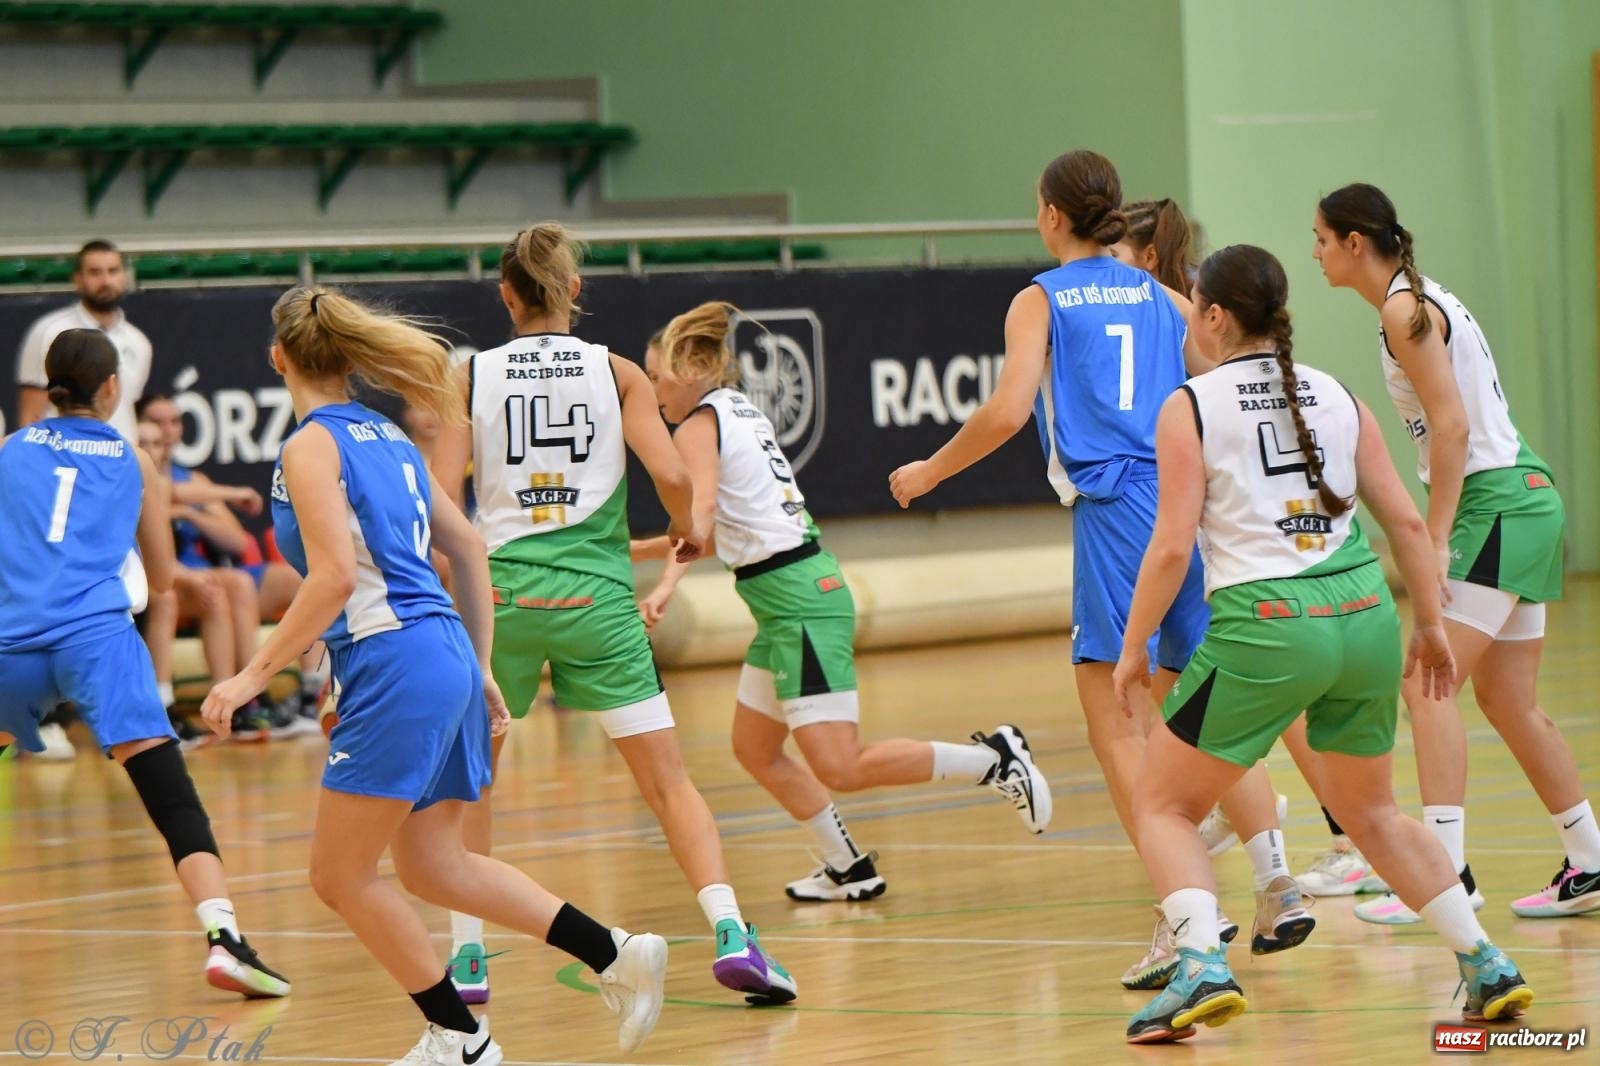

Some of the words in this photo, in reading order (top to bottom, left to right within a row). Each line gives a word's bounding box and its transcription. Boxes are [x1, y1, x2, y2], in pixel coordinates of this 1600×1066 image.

[1055, 287, 1083, 308] AZS
[1082, 282, 1102, 304] UŚ
[508, 352, 541, 363] RKK
[552, 351, 582, 362] AZS
[1105, 324, 1133, 411] 7
[506, 364, 585, 379] RACIBÓRZ
[871, 354, 1004, 427] RACI
[1236, 382, 1271, 395] RKK
[1238, 396, 1318, 411] RACIBRZ
[505, 394, 595, 466] 14
[1257, 421, 1325, 490] 4
[46, 466, 79, 542] 1
[521, 490, 575, 505] SEGET
